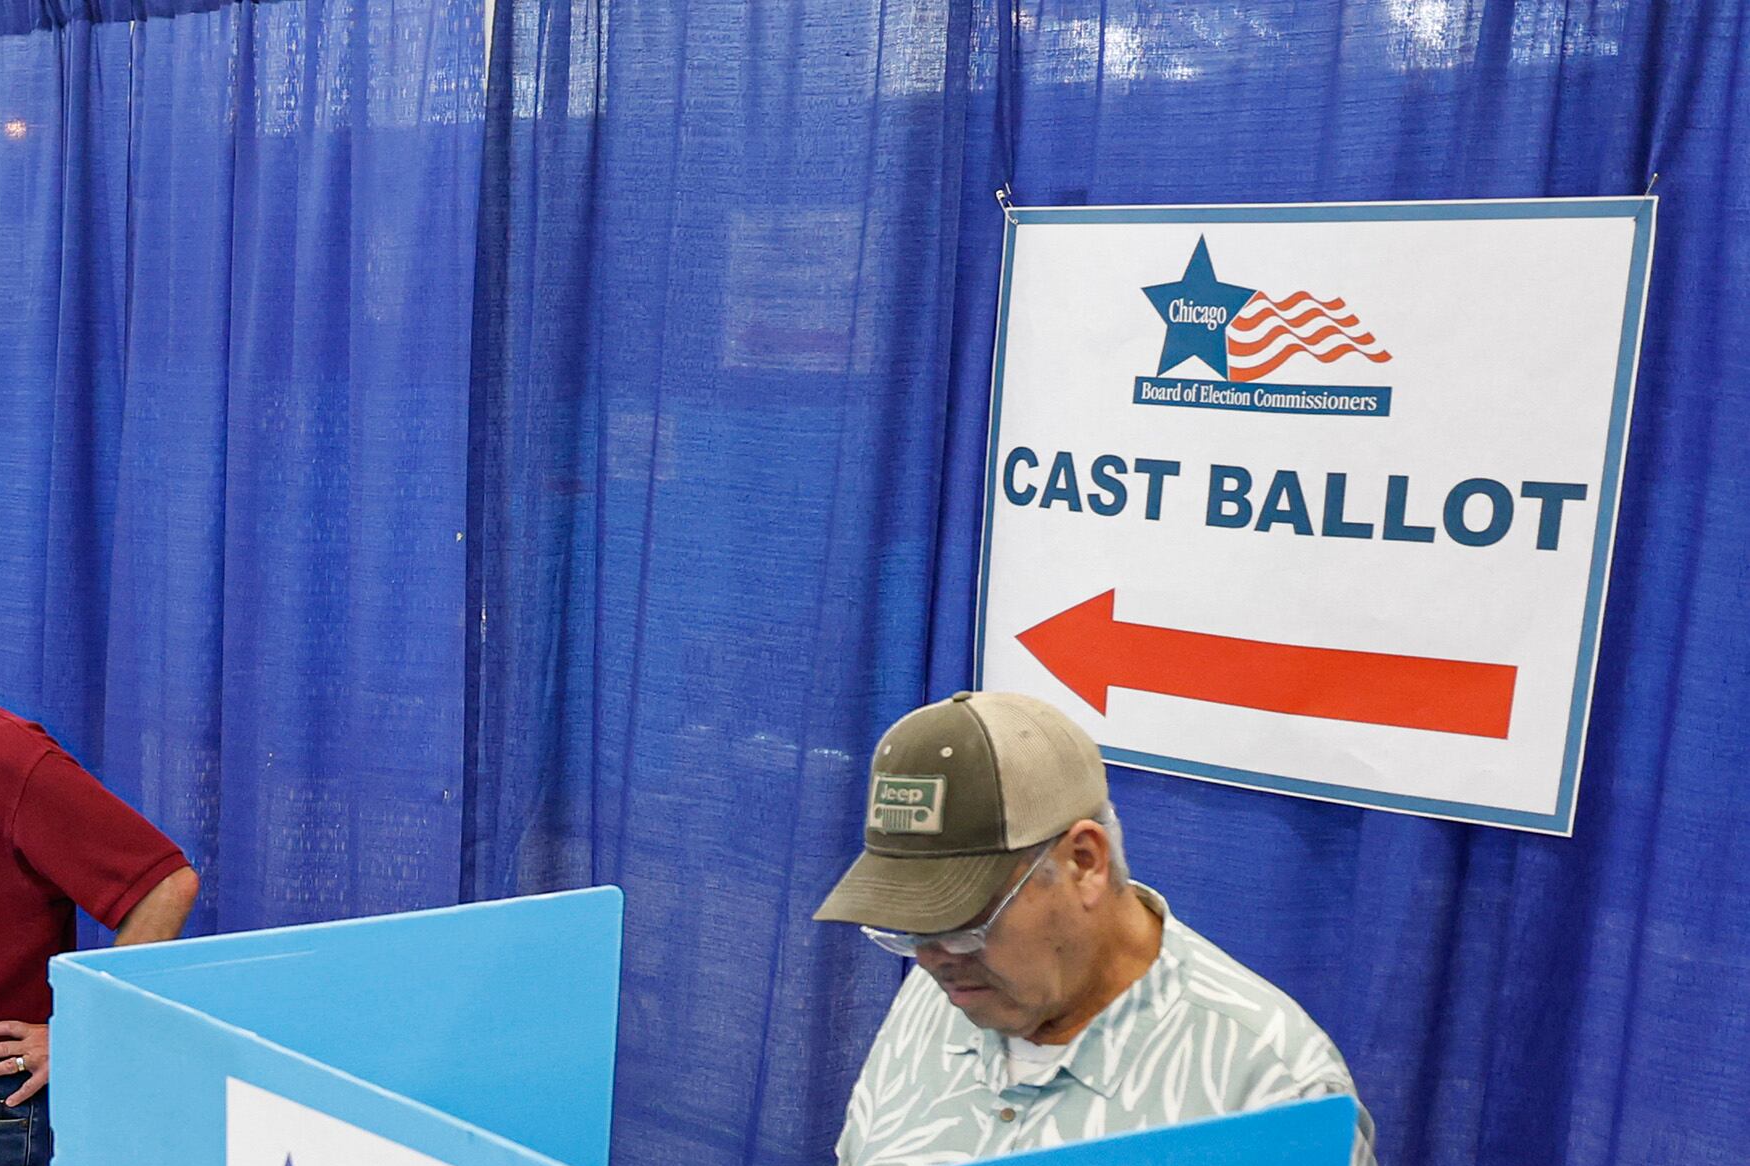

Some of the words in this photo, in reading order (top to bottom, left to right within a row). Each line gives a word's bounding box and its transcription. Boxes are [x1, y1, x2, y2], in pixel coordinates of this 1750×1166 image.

[1168, 297, 1227, 331] Chicago
[1141, 382, 1181, 400] Board
[1183, 385, 1198, 403] of
[1200, 385, 1250, 406] Election
[1254, 388, 1378, 411] Commissioners
[1002, 446, 1181, 521] CAST
[1205, 464, 1588, 551] BALLOT
[880, 783, 924, 804] Jeep
